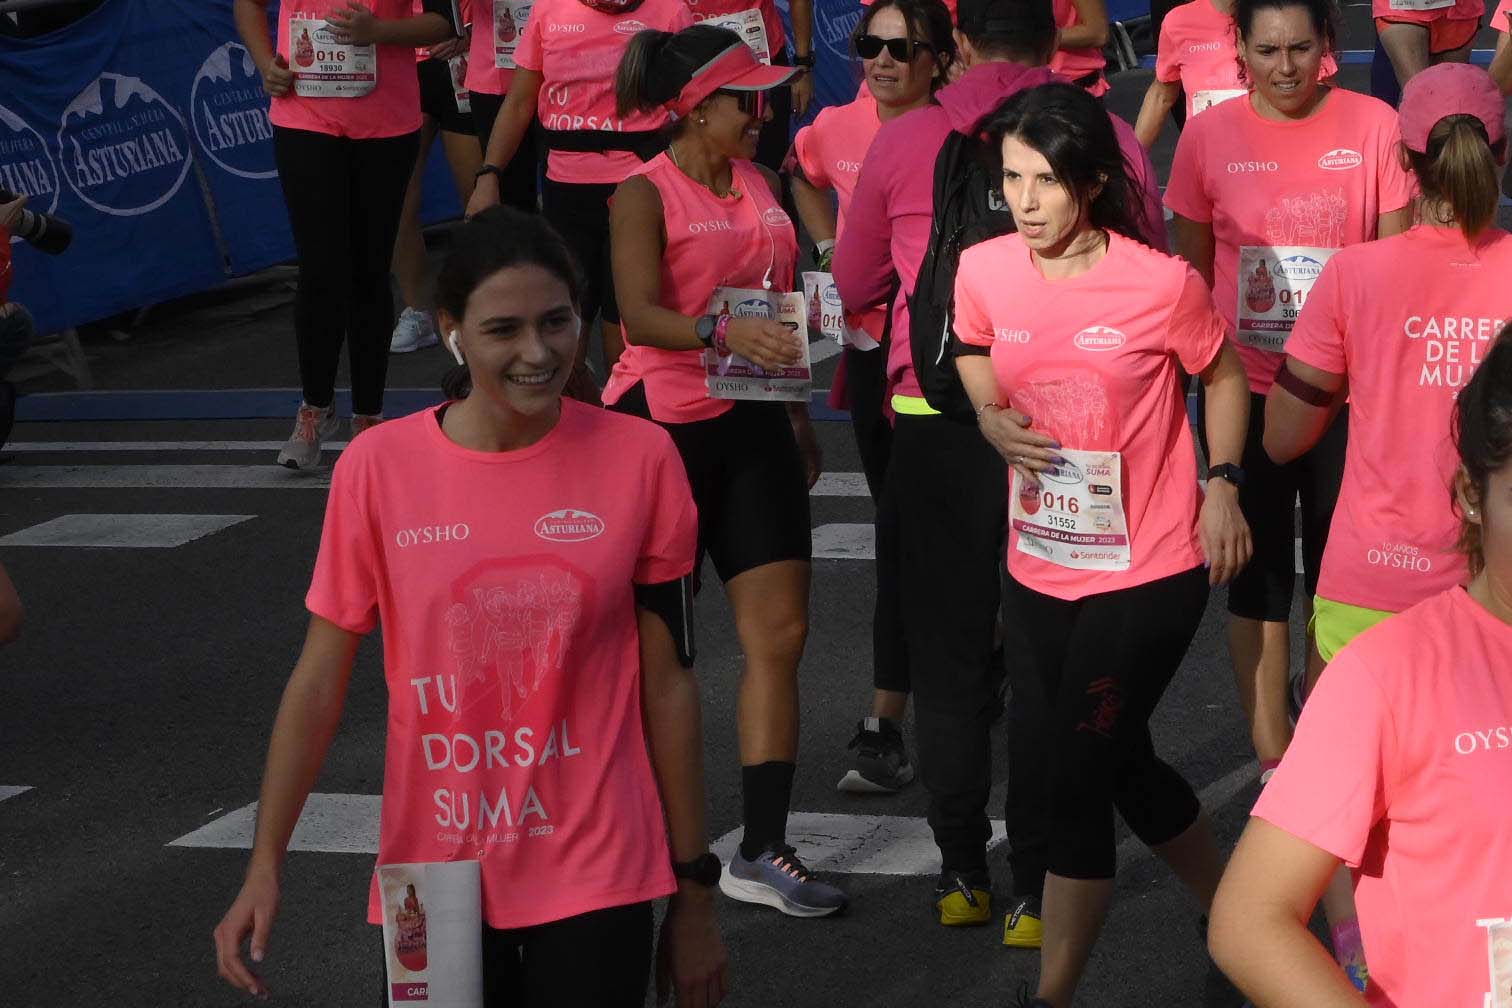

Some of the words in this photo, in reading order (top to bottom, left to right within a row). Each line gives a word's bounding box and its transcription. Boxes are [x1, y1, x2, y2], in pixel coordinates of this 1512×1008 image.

[316, 50, 346, 62] 016
[320, 64, 343, 72] 18930
[1228, 161, 1278, 174] OYSHO
[1322, 156, 1359, 167] ASTURIANA
[1279, 289, 1306, 304] 01
[993, 328, 1030, 343] YSHO
[1079, 335, 1122, 345] ASTURIANA
[1425, 341, 1459, 362] DE
[716, 382, 748, 392] OYSHO
[1086, 468, 1111, 476] SUMA
[1043, 492, 1079, 513] 016
[539, 521, 600, 535] ASTURIANA
[1048, 515, 1076, 529] 31552
[396, 523, 470, 548] OYSHO
[1022, 525, 1049, 536] CARRERA
[1080, 552, 1120, 560] Santander
[1392, 544, 1419, 556] AÑOS
[1367, 549, 1432, 573] OYSHO
[410, 673, 459, 715] TU
[421, 718, 582, 774] DORSAL
[433, 784, 550, 831] SUMA
[528, 824, 555, 838] 2023
